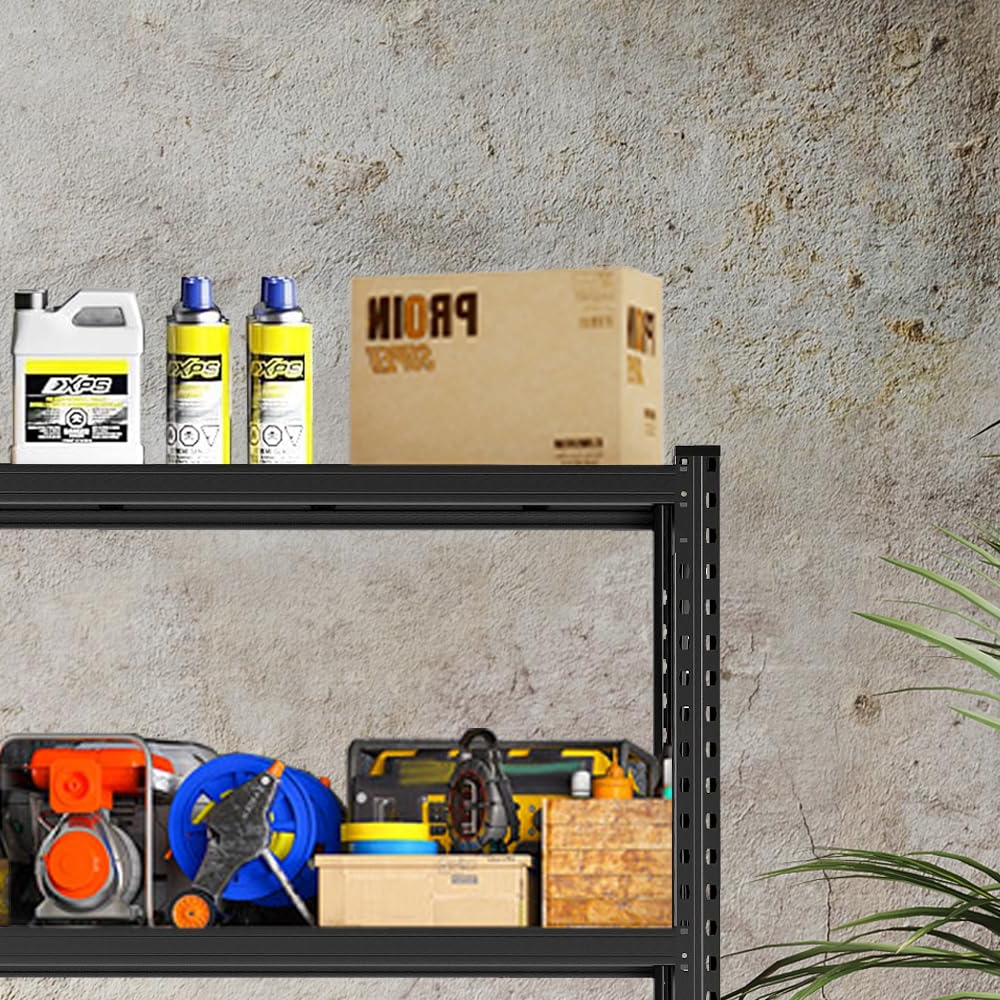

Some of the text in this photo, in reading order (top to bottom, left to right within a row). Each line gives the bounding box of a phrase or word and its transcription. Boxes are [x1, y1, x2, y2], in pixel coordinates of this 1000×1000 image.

[174, 357, 221, 379] XPS
[257, 357, 304, 379] XPS
[57, 374, 112, 394] XPS
